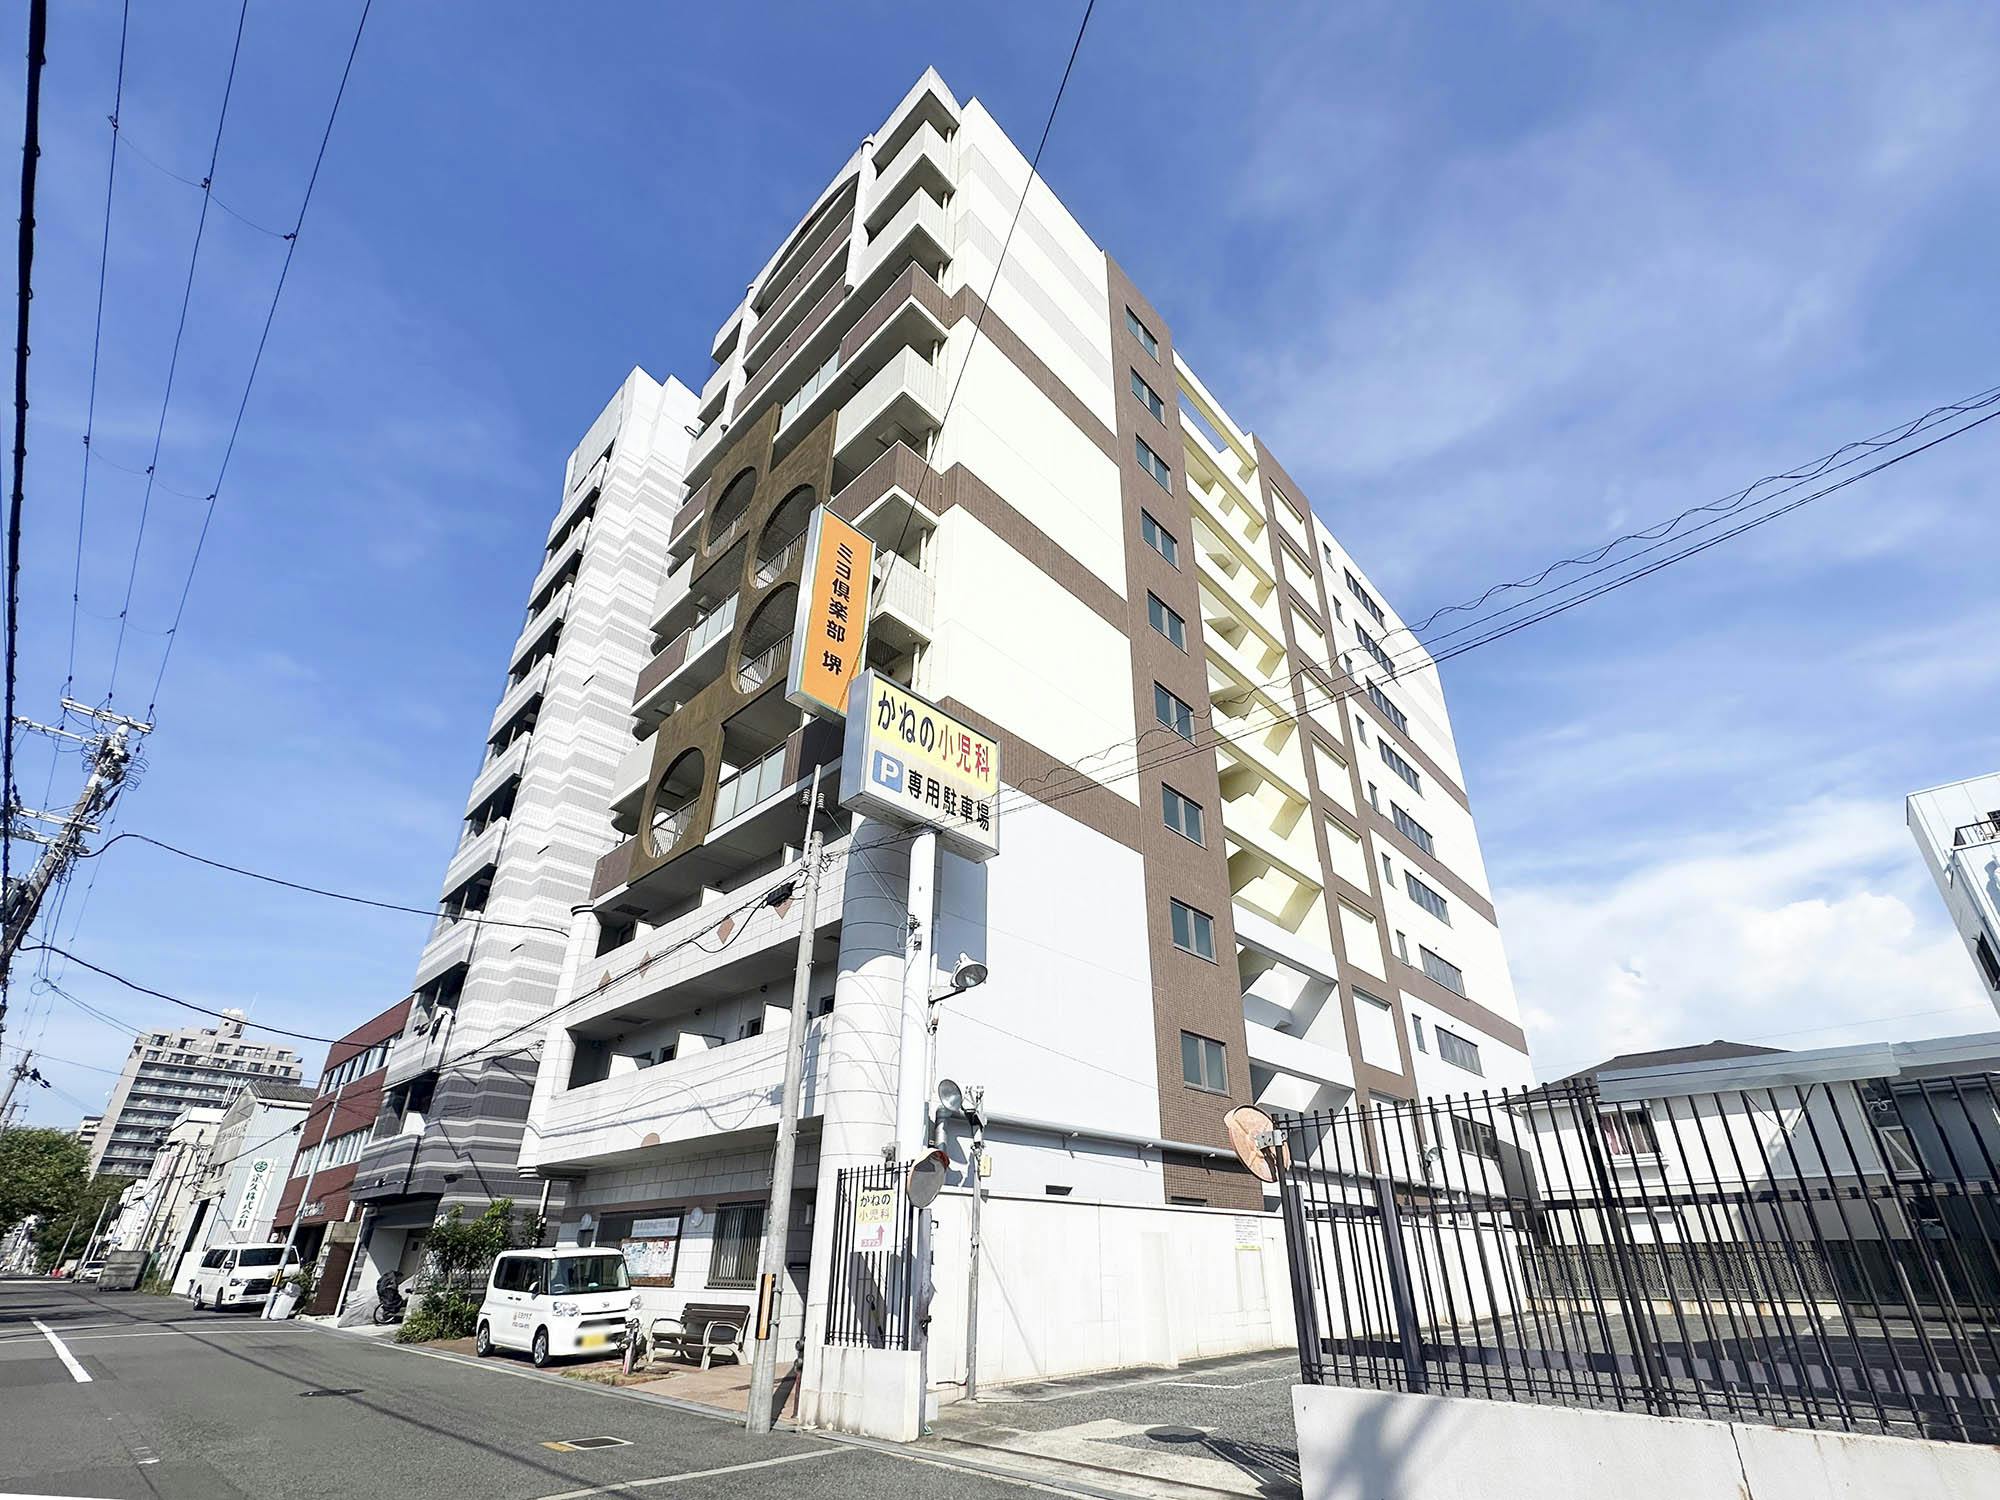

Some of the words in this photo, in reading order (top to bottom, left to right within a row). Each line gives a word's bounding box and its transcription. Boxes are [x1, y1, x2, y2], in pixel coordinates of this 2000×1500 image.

[827, 542, 853, 642] ミヨ倶楽部
[822, 650, 842, 676] 堺
[878, 690, 990, 782] かねの小児科
[880, 756, 900, 783] P
[908, 769, 989, 831] 専用駐車場
[860, 1194, 890, 1207] かねの
[859, 1209, 889, 1221] 小児科
